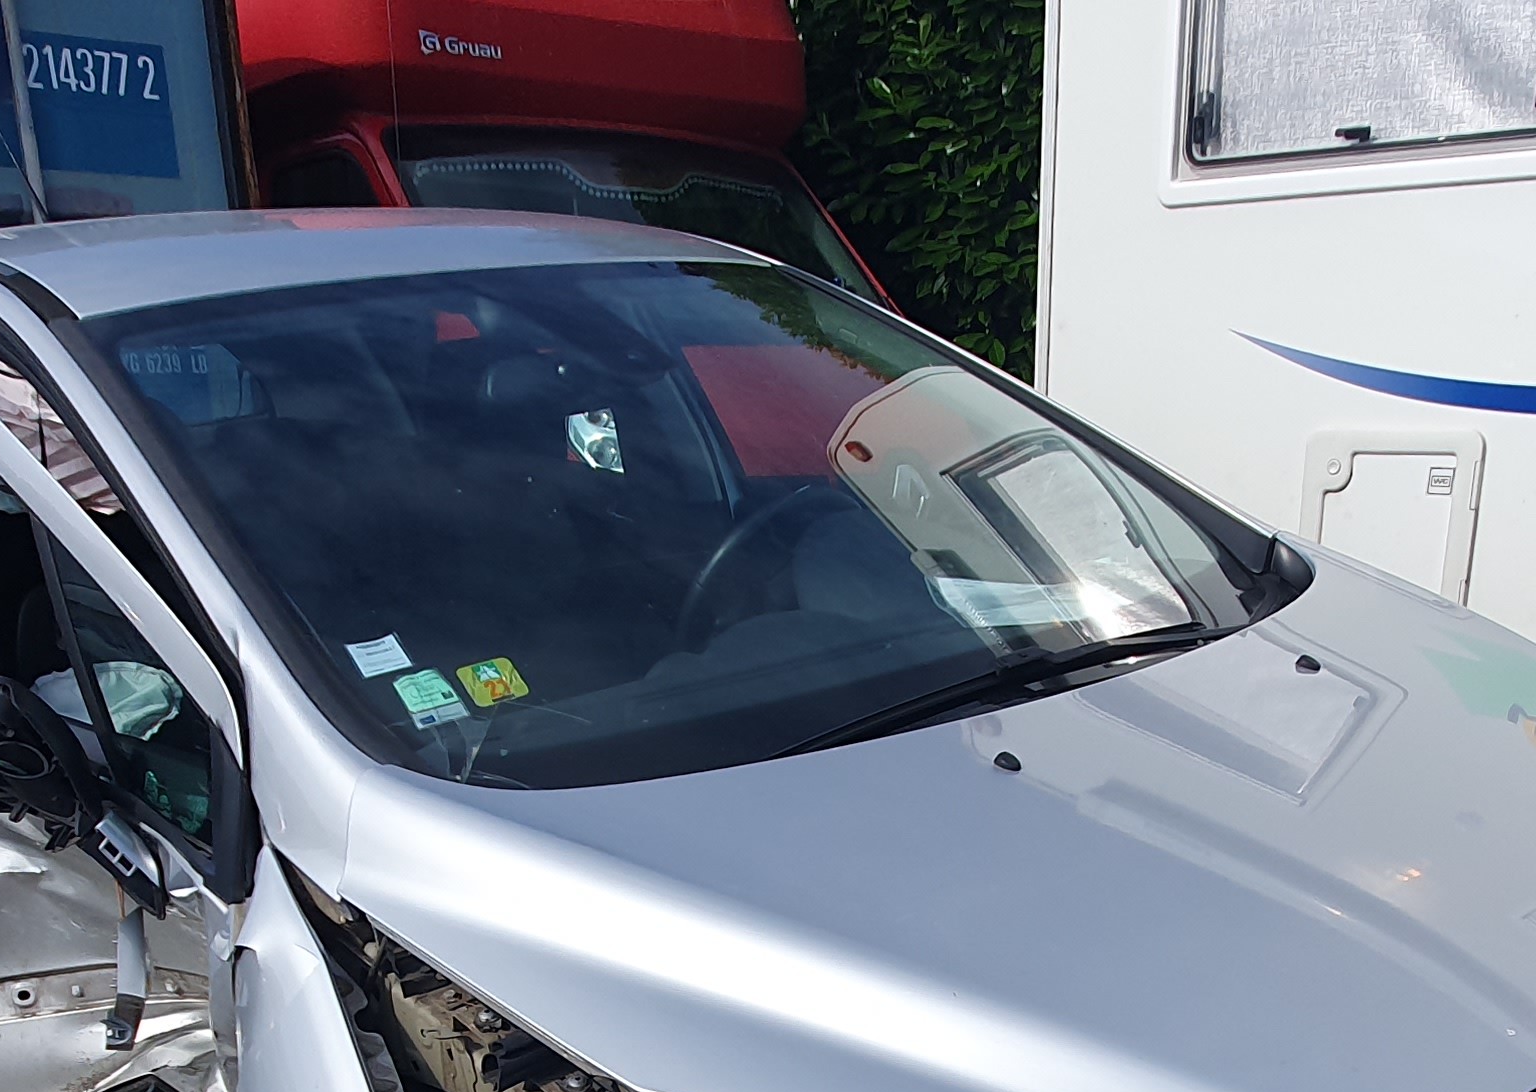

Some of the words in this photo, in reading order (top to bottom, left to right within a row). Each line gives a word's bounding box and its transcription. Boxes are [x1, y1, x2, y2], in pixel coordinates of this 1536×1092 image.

[444, 36, 502, 59] Gruau
[23, 44, 128, 97] 214377
[138, 55, 160, 101] 2
